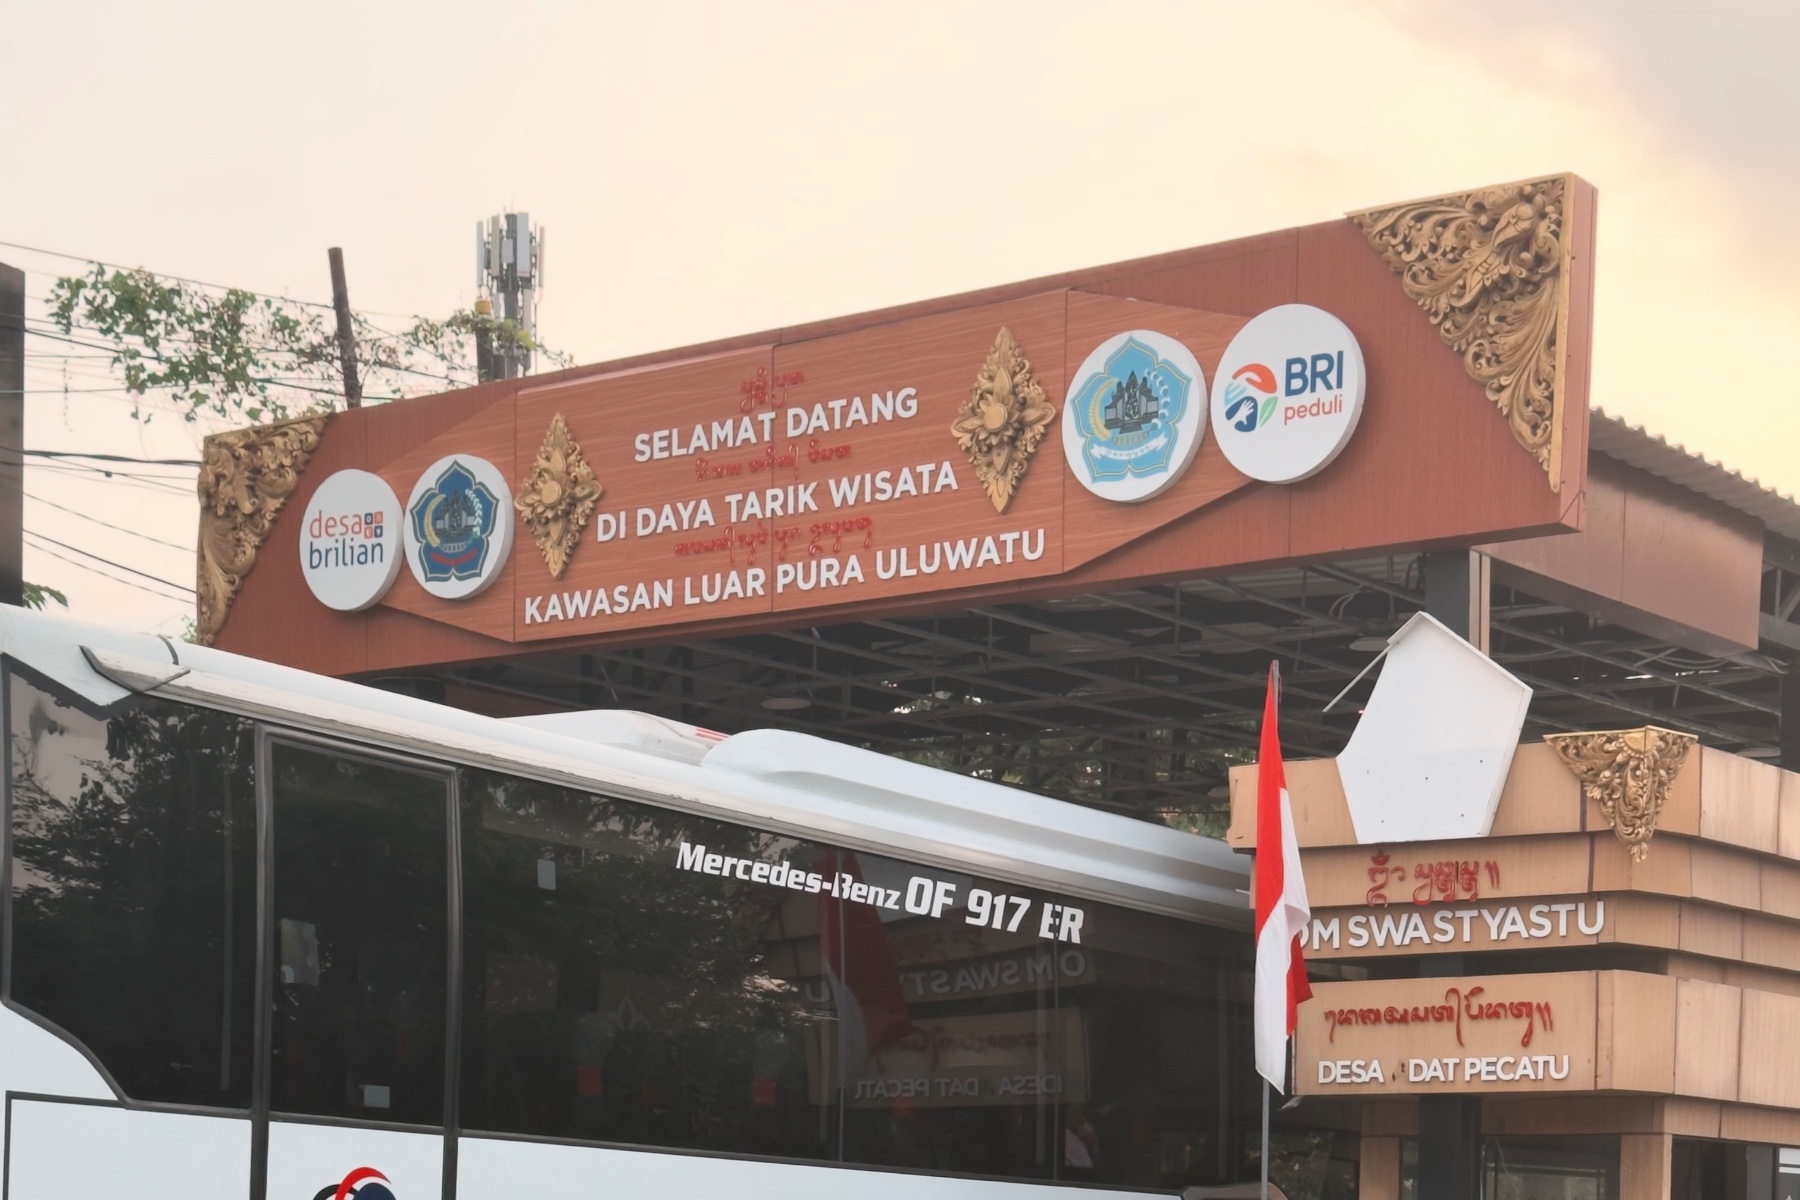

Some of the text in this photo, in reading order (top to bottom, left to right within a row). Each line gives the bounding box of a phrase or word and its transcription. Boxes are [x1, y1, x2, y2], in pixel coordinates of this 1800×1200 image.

[1284, 350, 1344, 397] BRI
[634, 411, 776, 463] SELAMAT
[786, 387, 918, 438] DATANG
[1284, 394, 1343, 426] peduli
[309, 510, 362, 539] desa
[597, 511, 626, 542] DI
[636, 499, 715, 537] DAYA
[724, 481, 818, 523] TARIK
[828, 461, 959, 509] WISATA
[309, 538, 384, 569] brilian
[525, 579, 673, 624] KAWASAN
[684, 567, 766, 605] LUAR
[776, 554, 865, 594] PURA
[876, 528, 1045, 580] ULUWATU
[676, 842, 1085, 945] Mercedes-Benz OF 917 ER
[1348, 901, 1605, 948] SWASTYASTU
[1318, 1060, 1384, 1084] DESA
[1464, 1055, 1570, 1081] PECATU
